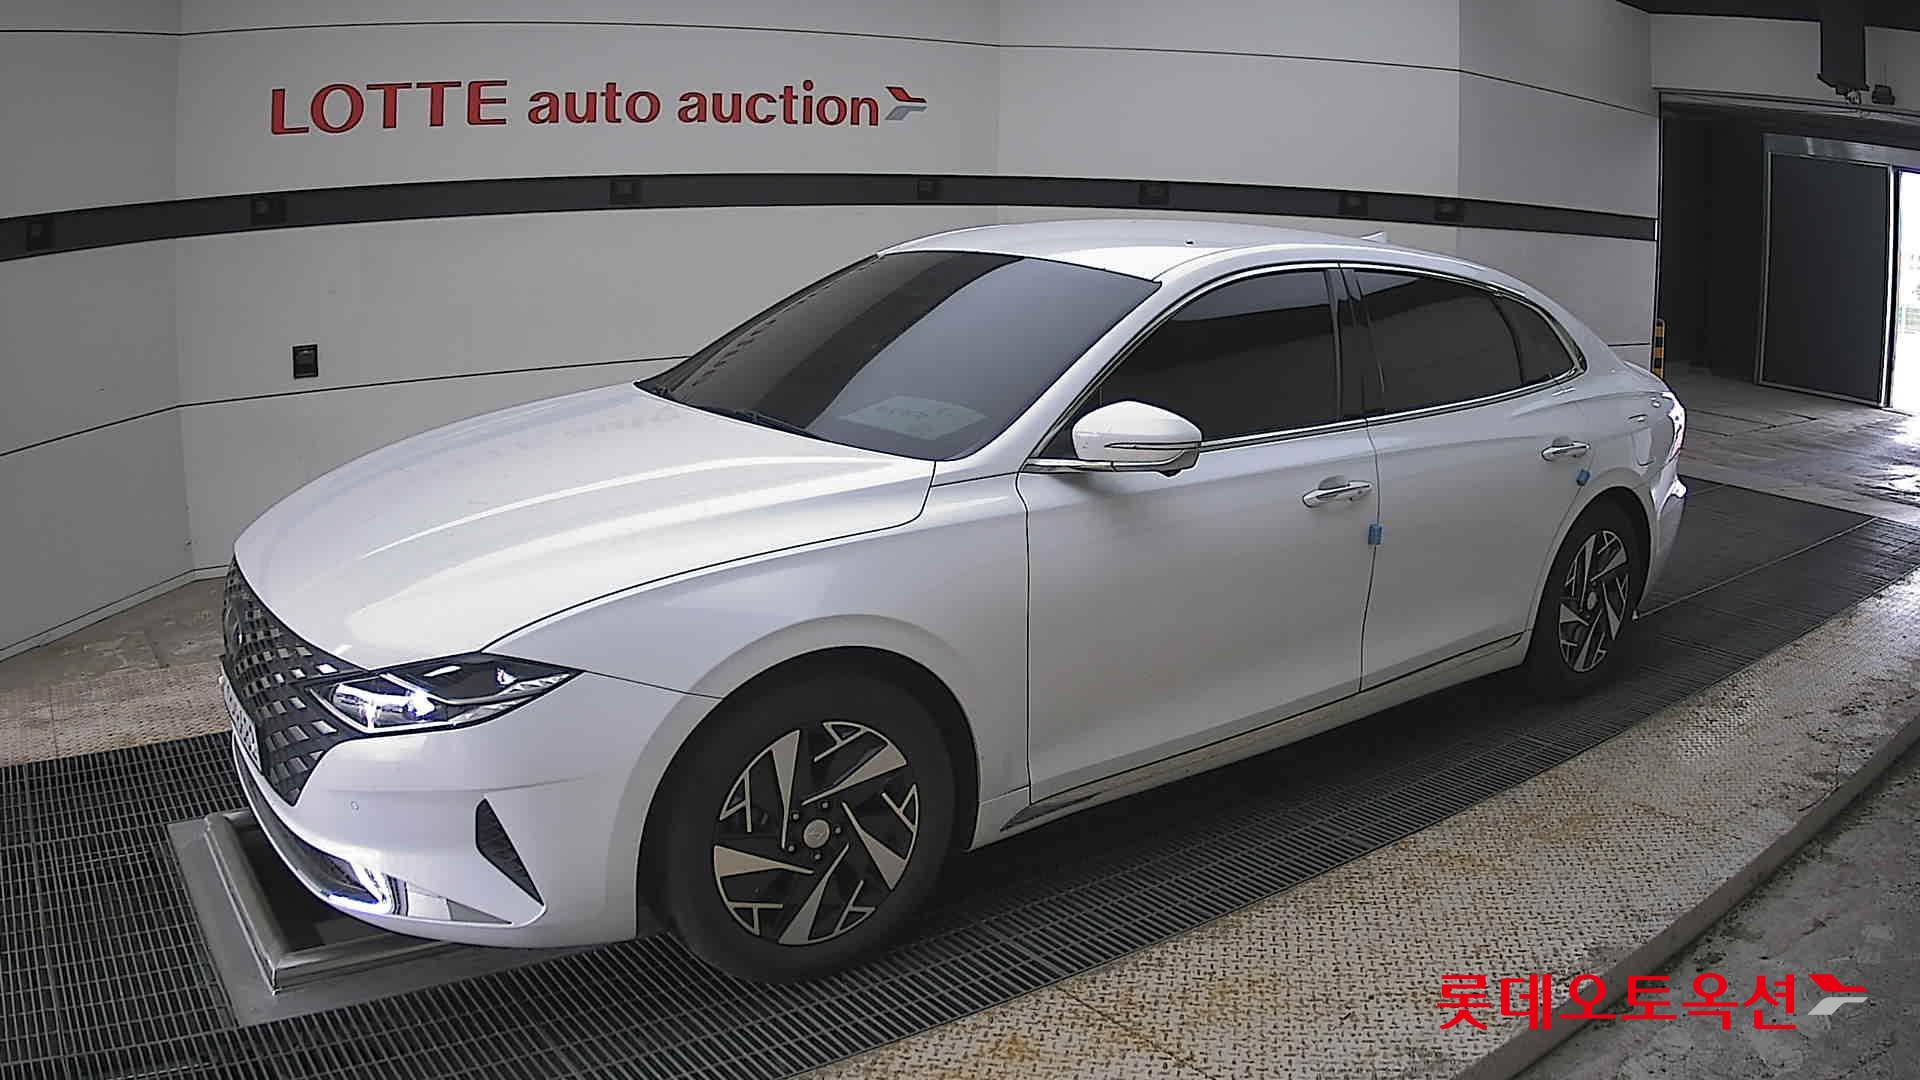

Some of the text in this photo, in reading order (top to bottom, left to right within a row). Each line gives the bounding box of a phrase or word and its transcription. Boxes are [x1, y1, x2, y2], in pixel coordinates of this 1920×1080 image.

[271, 79, 879, 135] LOTTE auto auction
